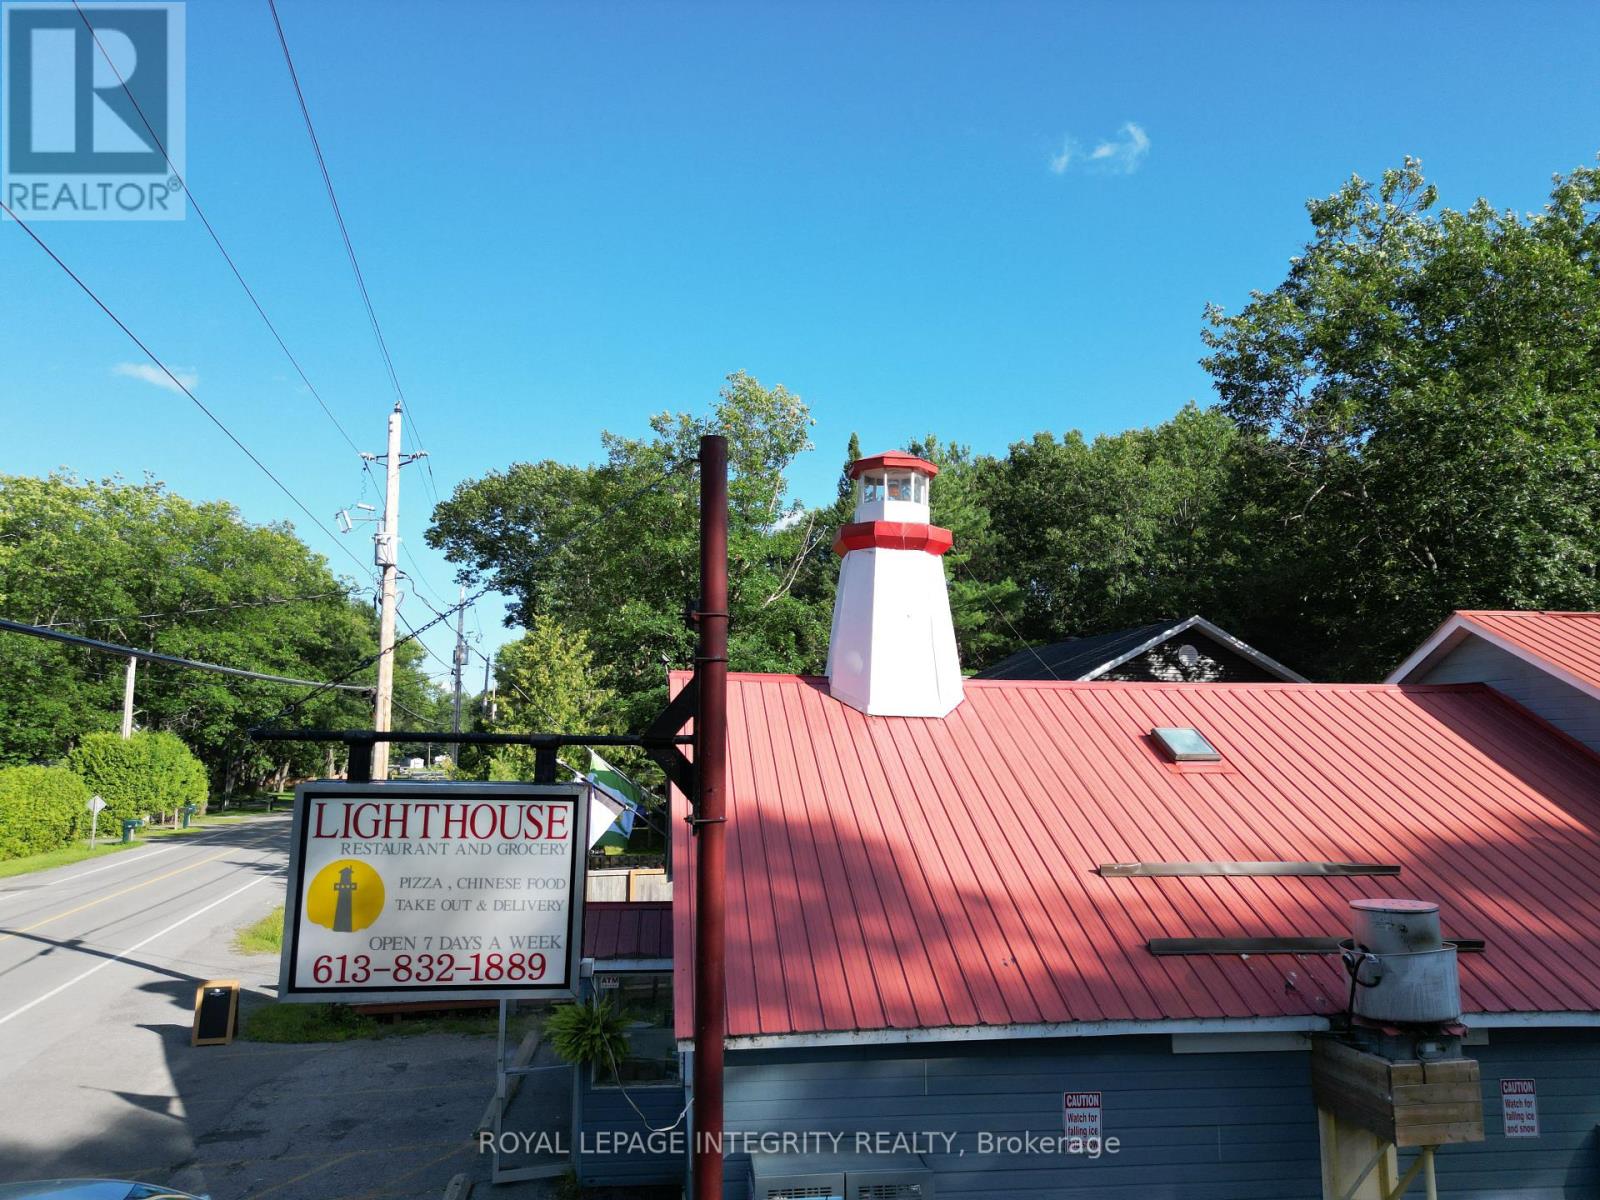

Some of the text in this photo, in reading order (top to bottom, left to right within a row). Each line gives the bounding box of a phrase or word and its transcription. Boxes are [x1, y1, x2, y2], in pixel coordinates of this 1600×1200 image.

[312, 802, 569, 840] LIGHTHOUSE
[340, 842, 569, 856] RESTAURANT AND GROCERY
[399, 877, 442, 889] PIZZA
[457, 878, 521, 889] CHINESE
[527, 878, 566, 889] FOOD
[395, 899, 565, 911] TAKE OUT & DELIVERY
[369, 935, 562, 951] OPEN 7 DAYS A WEEK
[313, 953, 546, 984] 613-832-1889
[1503, 1081, 1533, 1093] CAUTION
[1066, 1094, 1099, 1107] CAUTION
[1505, 1099, 1533, 1108] Watch for
[1068, 1113, 1098, 1123] Watch for
[1506, 1112, 1535, 1123] falling ice
[1068, 1126, 1099, 1138] falling ice
[1508, 1125, 1519, 1133] and
